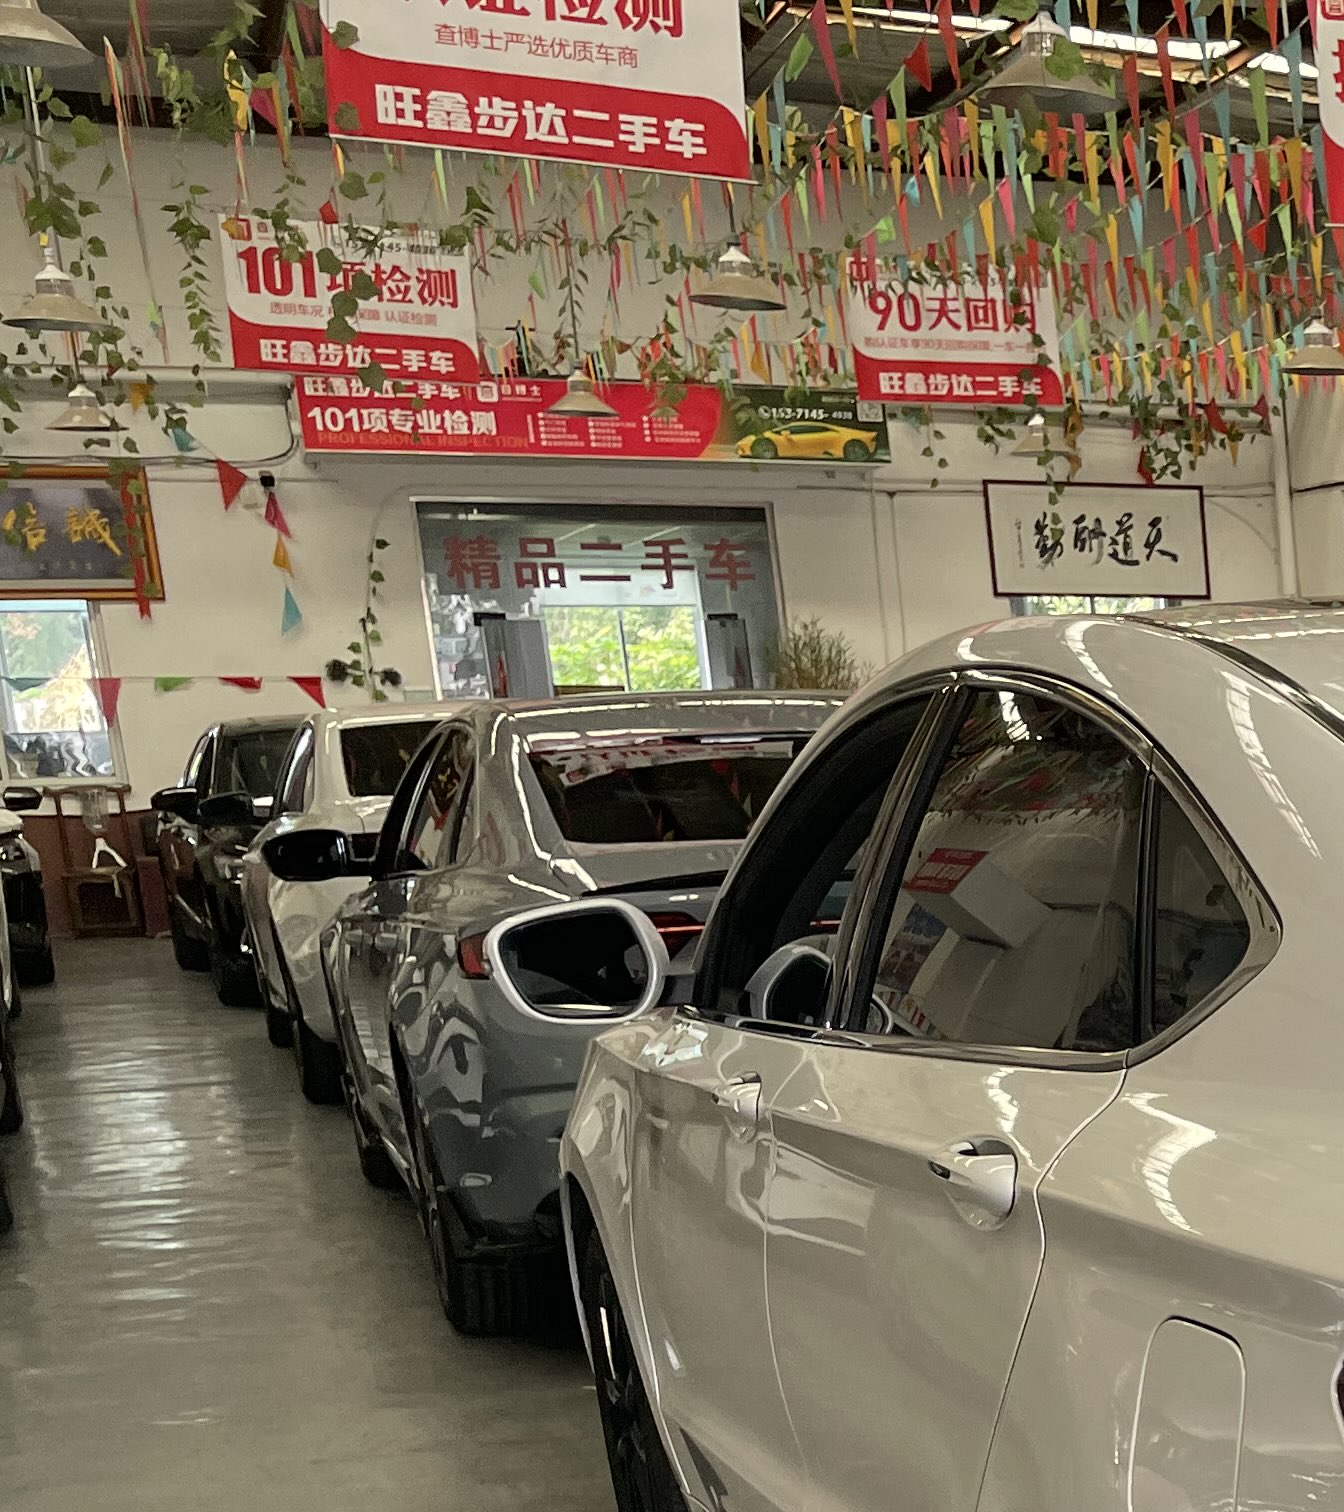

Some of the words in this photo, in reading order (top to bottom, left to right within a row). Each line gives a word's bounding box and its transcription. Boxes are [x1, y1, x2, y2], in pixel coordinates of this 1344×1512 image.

[434, 23, 639, 69] 查博士严选优质车商
[374, 83, 708, 159] 旺鑫步达二手车
[869, 290, 1036, 334] 90天回购
[259, 338, 455, 374] 旺鑫步达二手车
[308, 406, 498, 436] 101项专业检测
[443, 534, 756, 591] 精品二手车
